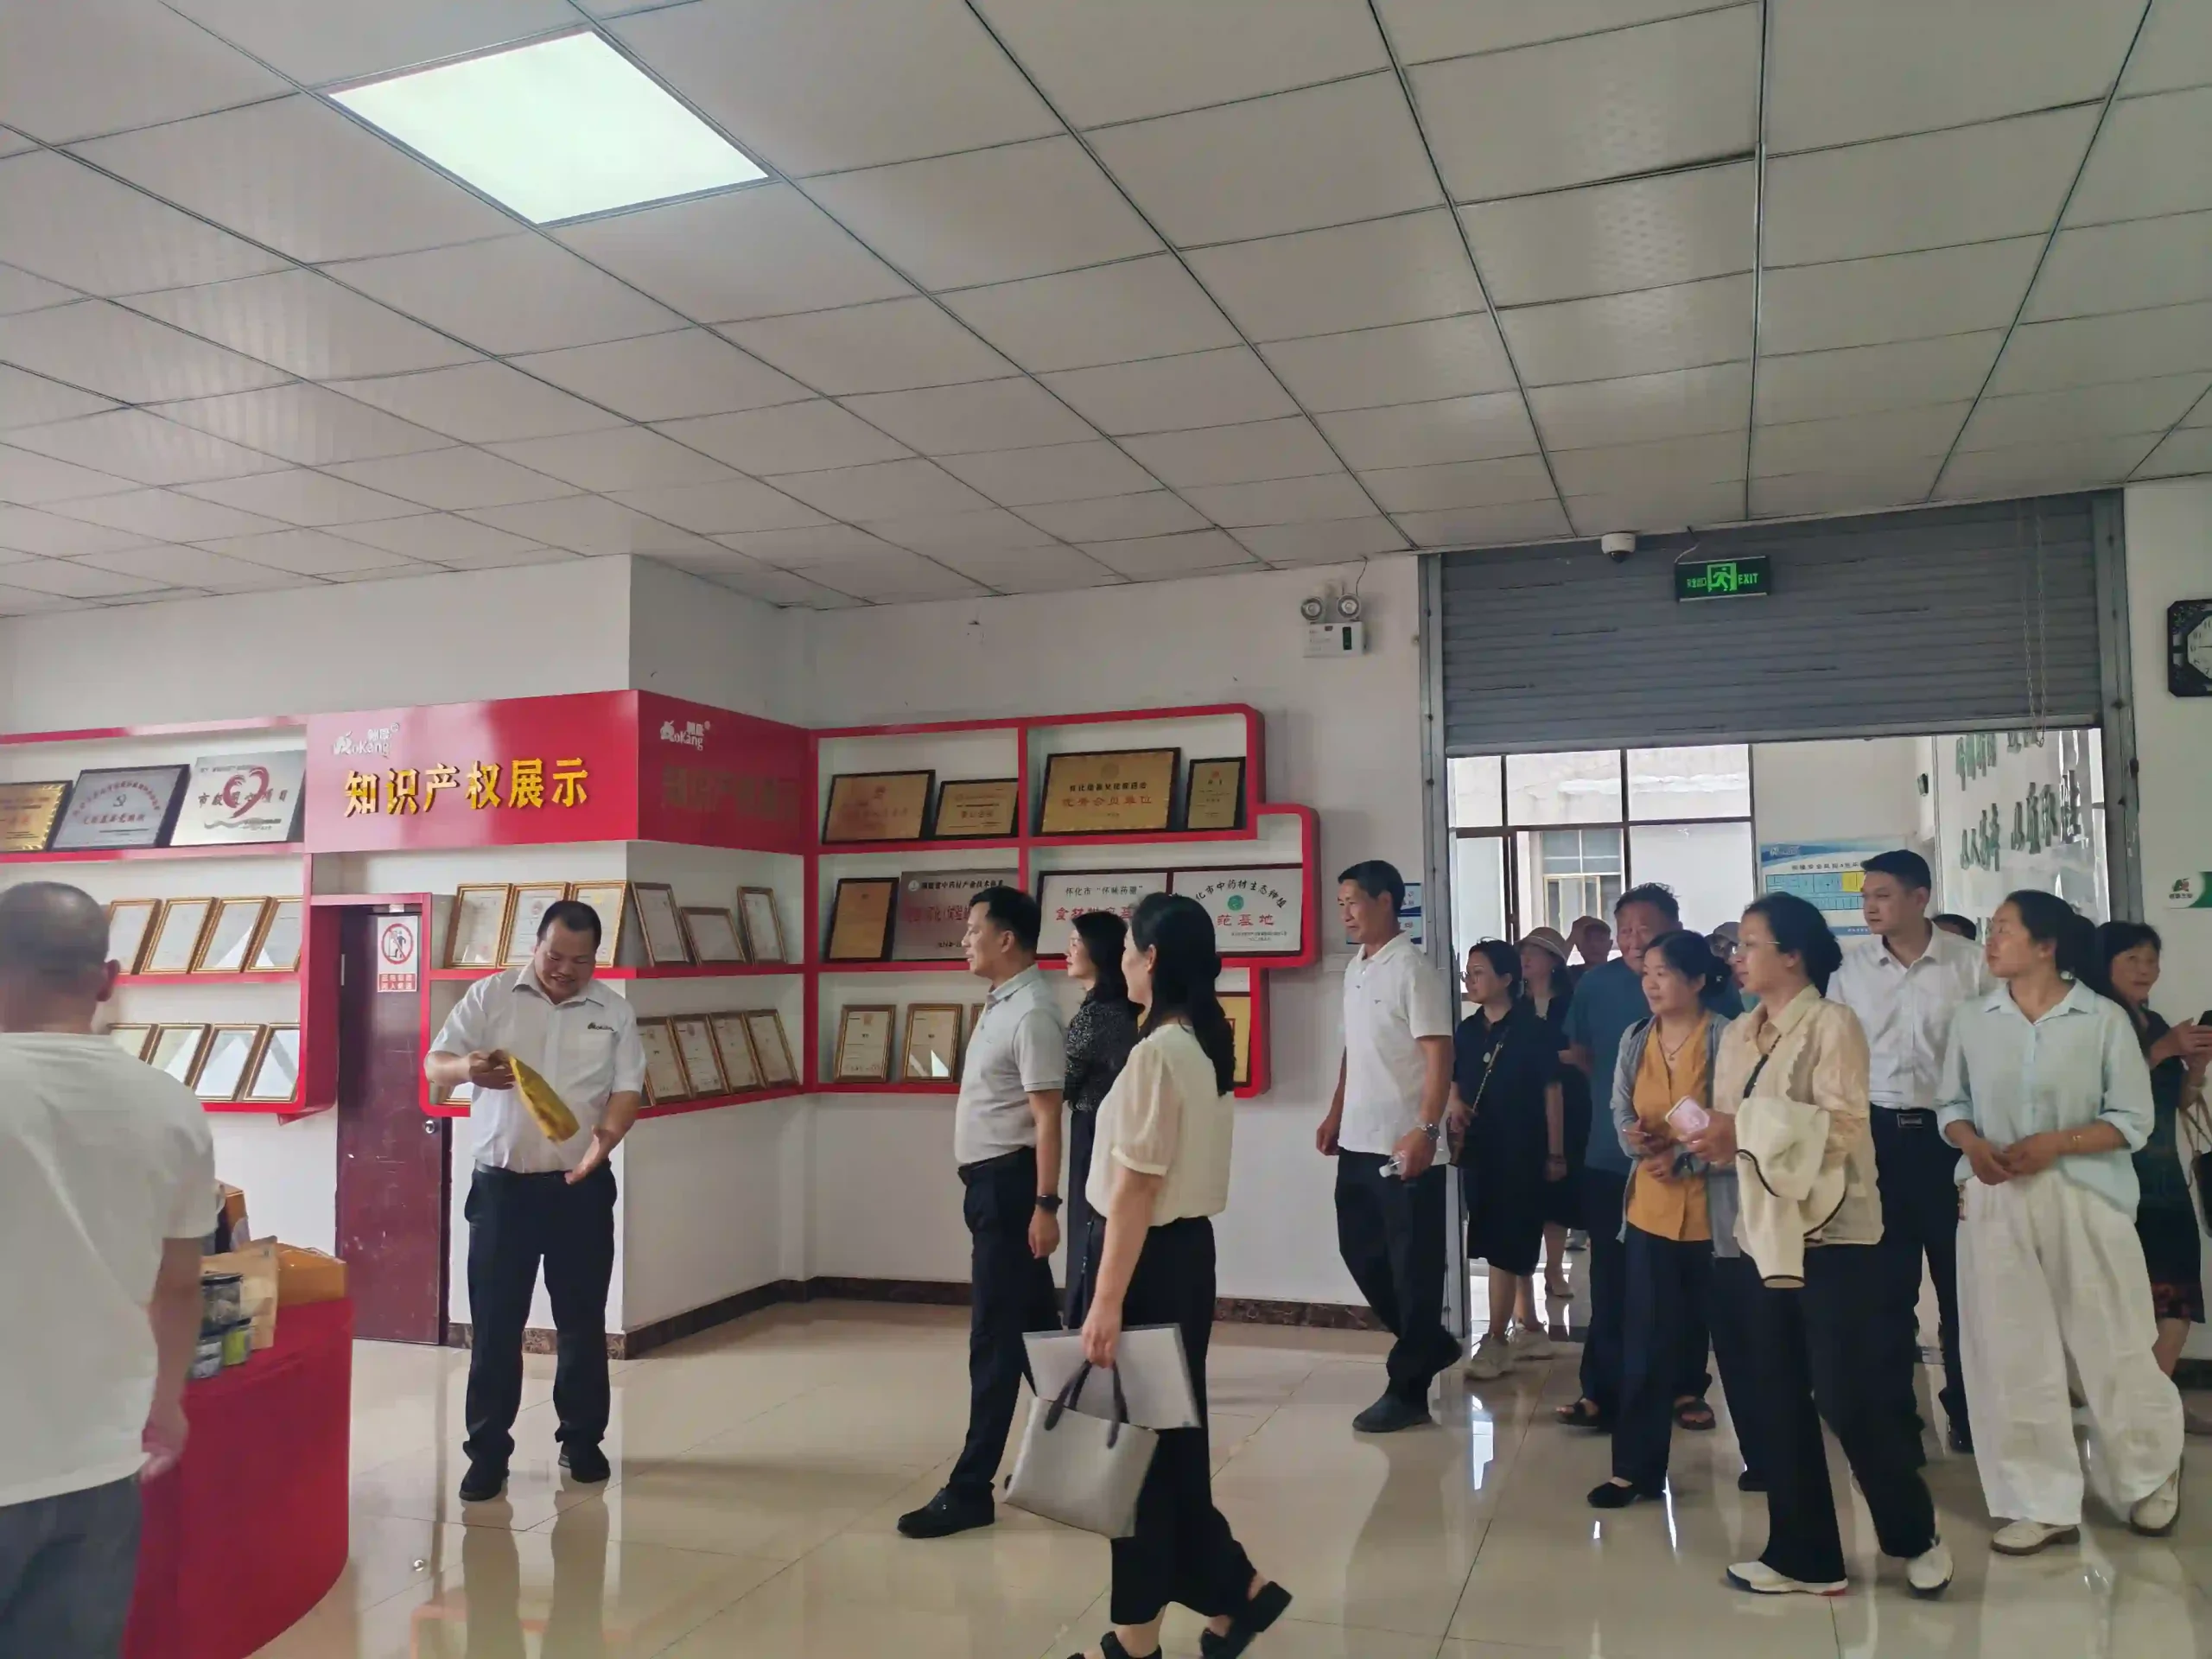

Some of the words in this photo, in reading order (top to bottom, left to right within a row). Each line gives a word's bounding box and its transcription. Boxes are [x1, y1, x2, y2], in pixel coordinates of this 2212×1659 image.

[1738, 573, 1758, 585] EXIT
[345, 757, 589, 817] 知识产权展示
[1195, 880, 1287, 908] 化市中药材生态种植
[1217, 913, 1274, 926] 范基地
